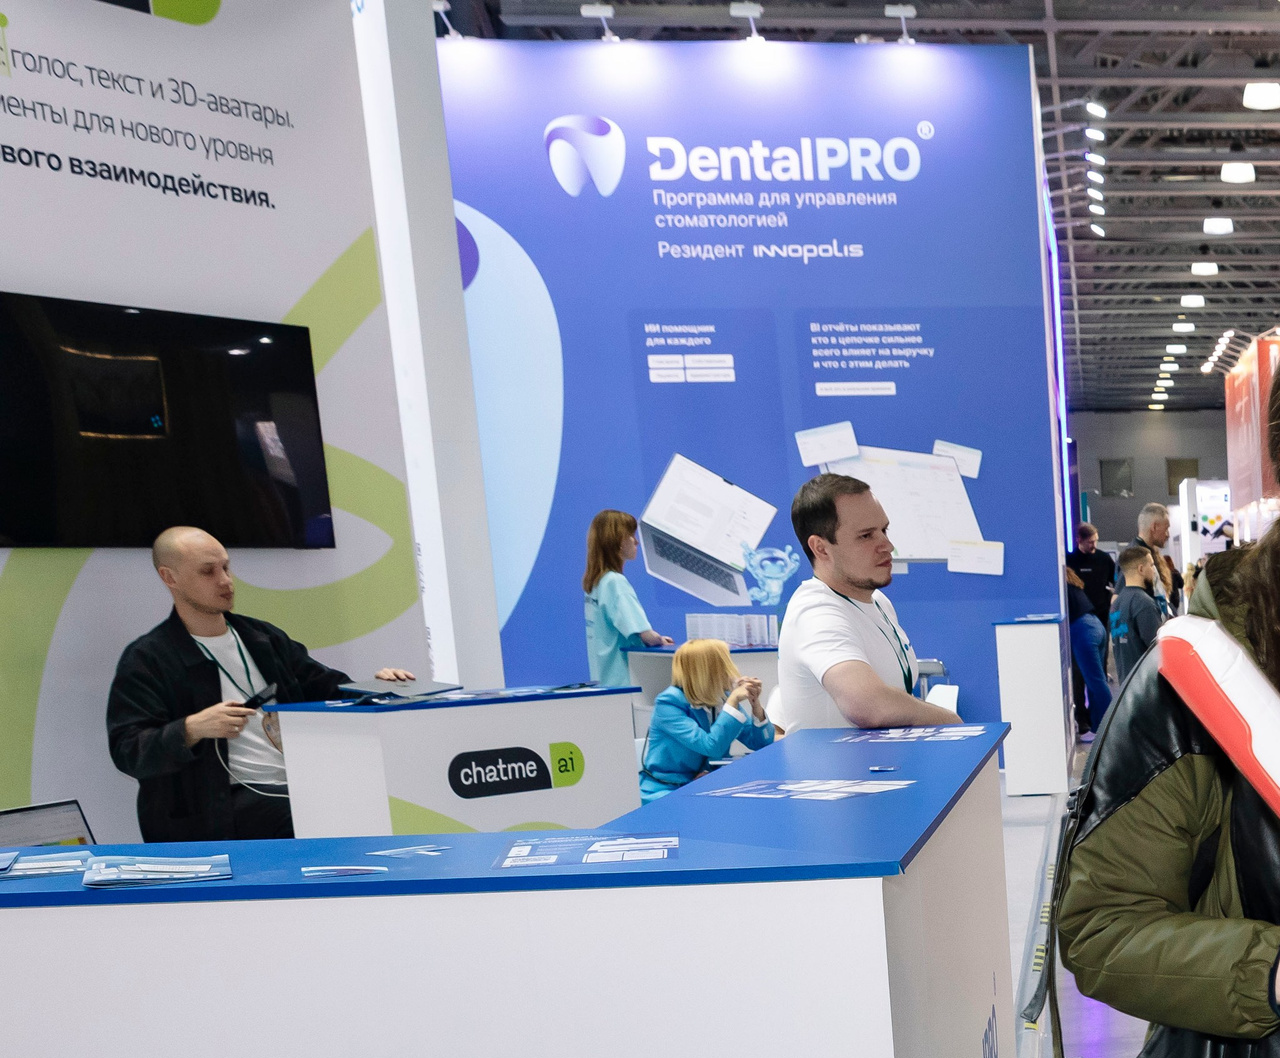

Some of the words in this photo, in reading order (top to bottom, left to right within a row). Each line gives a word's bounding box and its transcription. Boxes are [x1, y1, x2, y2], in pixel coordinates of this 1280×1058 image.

[84, 65, 145, 96] текст
[150, 80, 164, 101] и
[168, 78, 294, 129] 3D-аватары.
[73, 109, 115, 134] для
[119, 118, 197, 151] нового
[199, 133, 274, 166] уровня
[68, 156, 276, 209] взаимодействия.
[652, 188, 754, 209] Программа
[758, 192, 790, 208] для
[795, 191, 898, 209] управления
[655, 211, 788, 228] стоматологией
[657, 240, 745, 261] Резидент
[460, 758, 538, 785] chatme
[557, 751, 575, 774] ai
